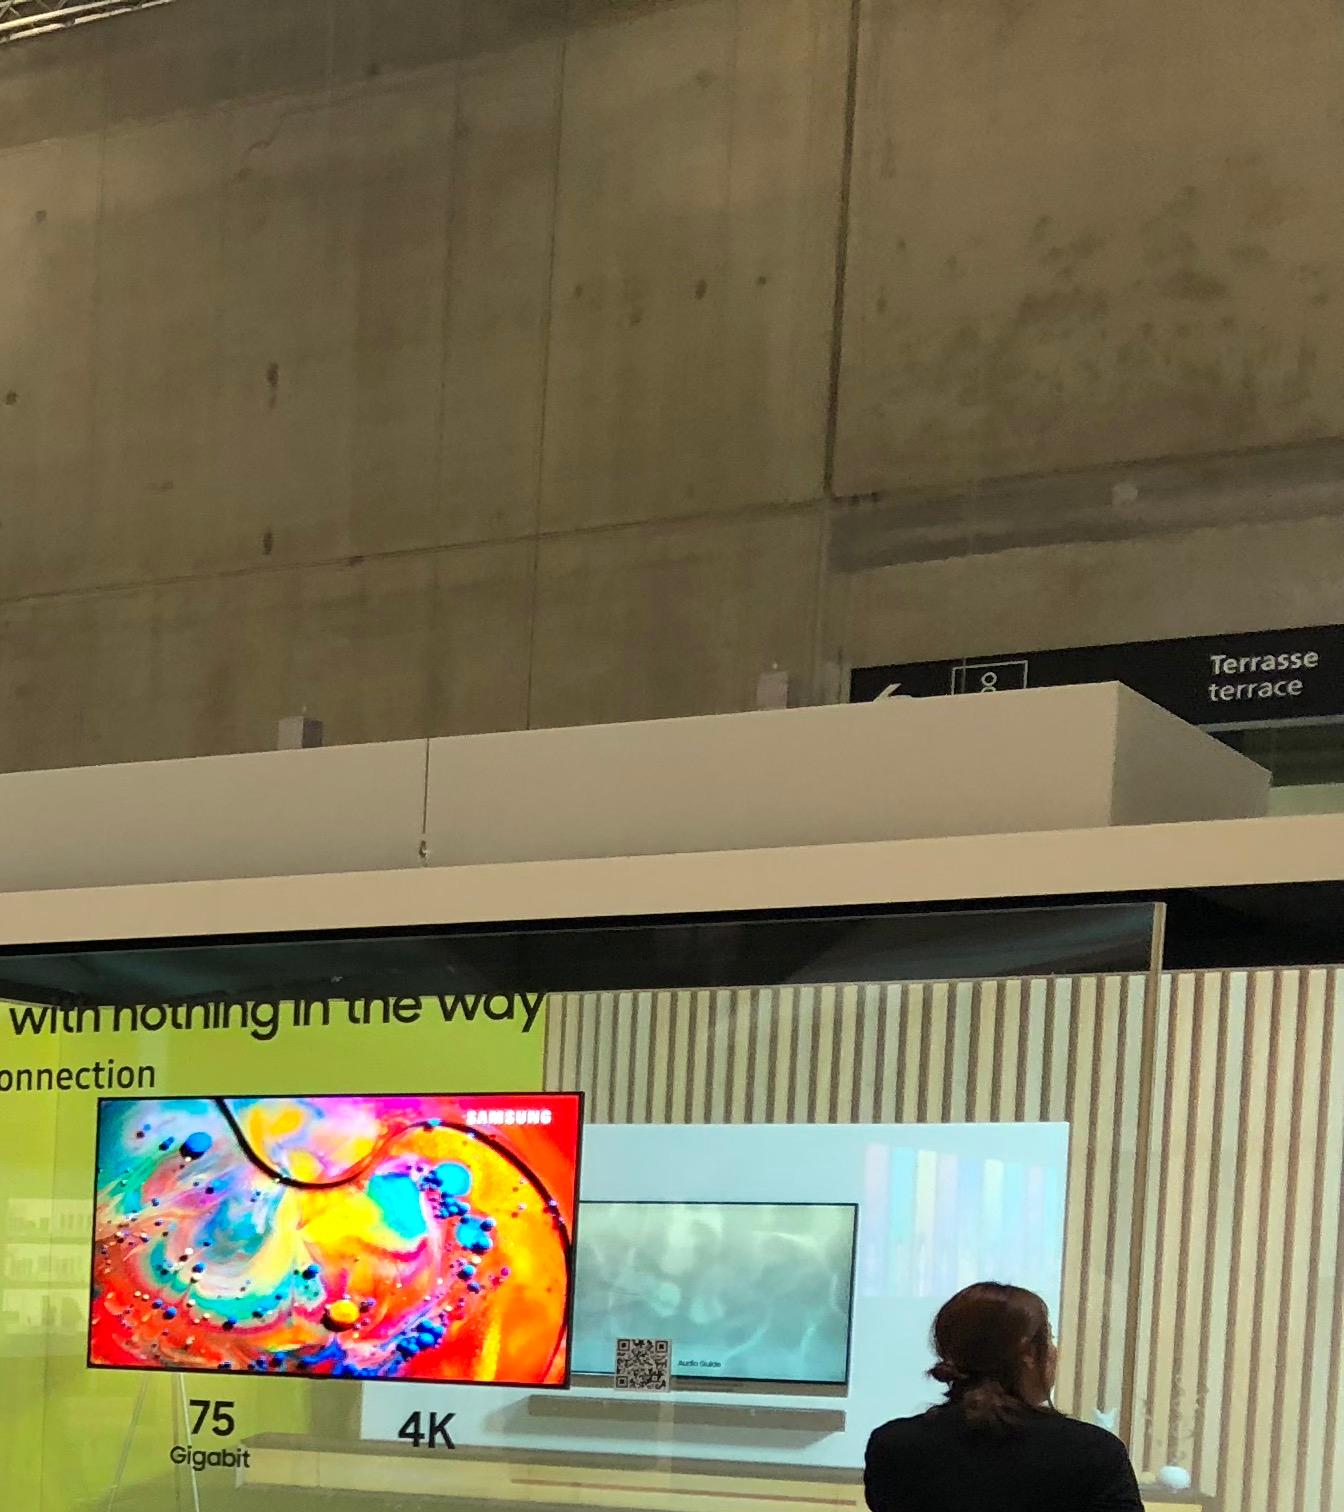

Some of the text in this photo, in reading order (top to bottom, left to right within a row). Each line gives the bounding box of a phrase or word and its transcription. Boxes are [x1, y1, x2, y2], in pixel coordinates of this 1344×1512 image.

[1210, 650, 1319, 675] Terrasse
[1208, 679, 1304, 702] terrace
[9, 1005, 100, 1036] with
[113, 1000, 281, 1040] nothing
[293, 998, 330, 1027] in
[348, 996, 423, 1024] the
[438, 992, 545, 1033] way
[466, 1109, 552, 1126] SAMSUNG
[189, 1399, 456, 1449] 75 4K
[170, 1445, 250, 1471] Gigabit
